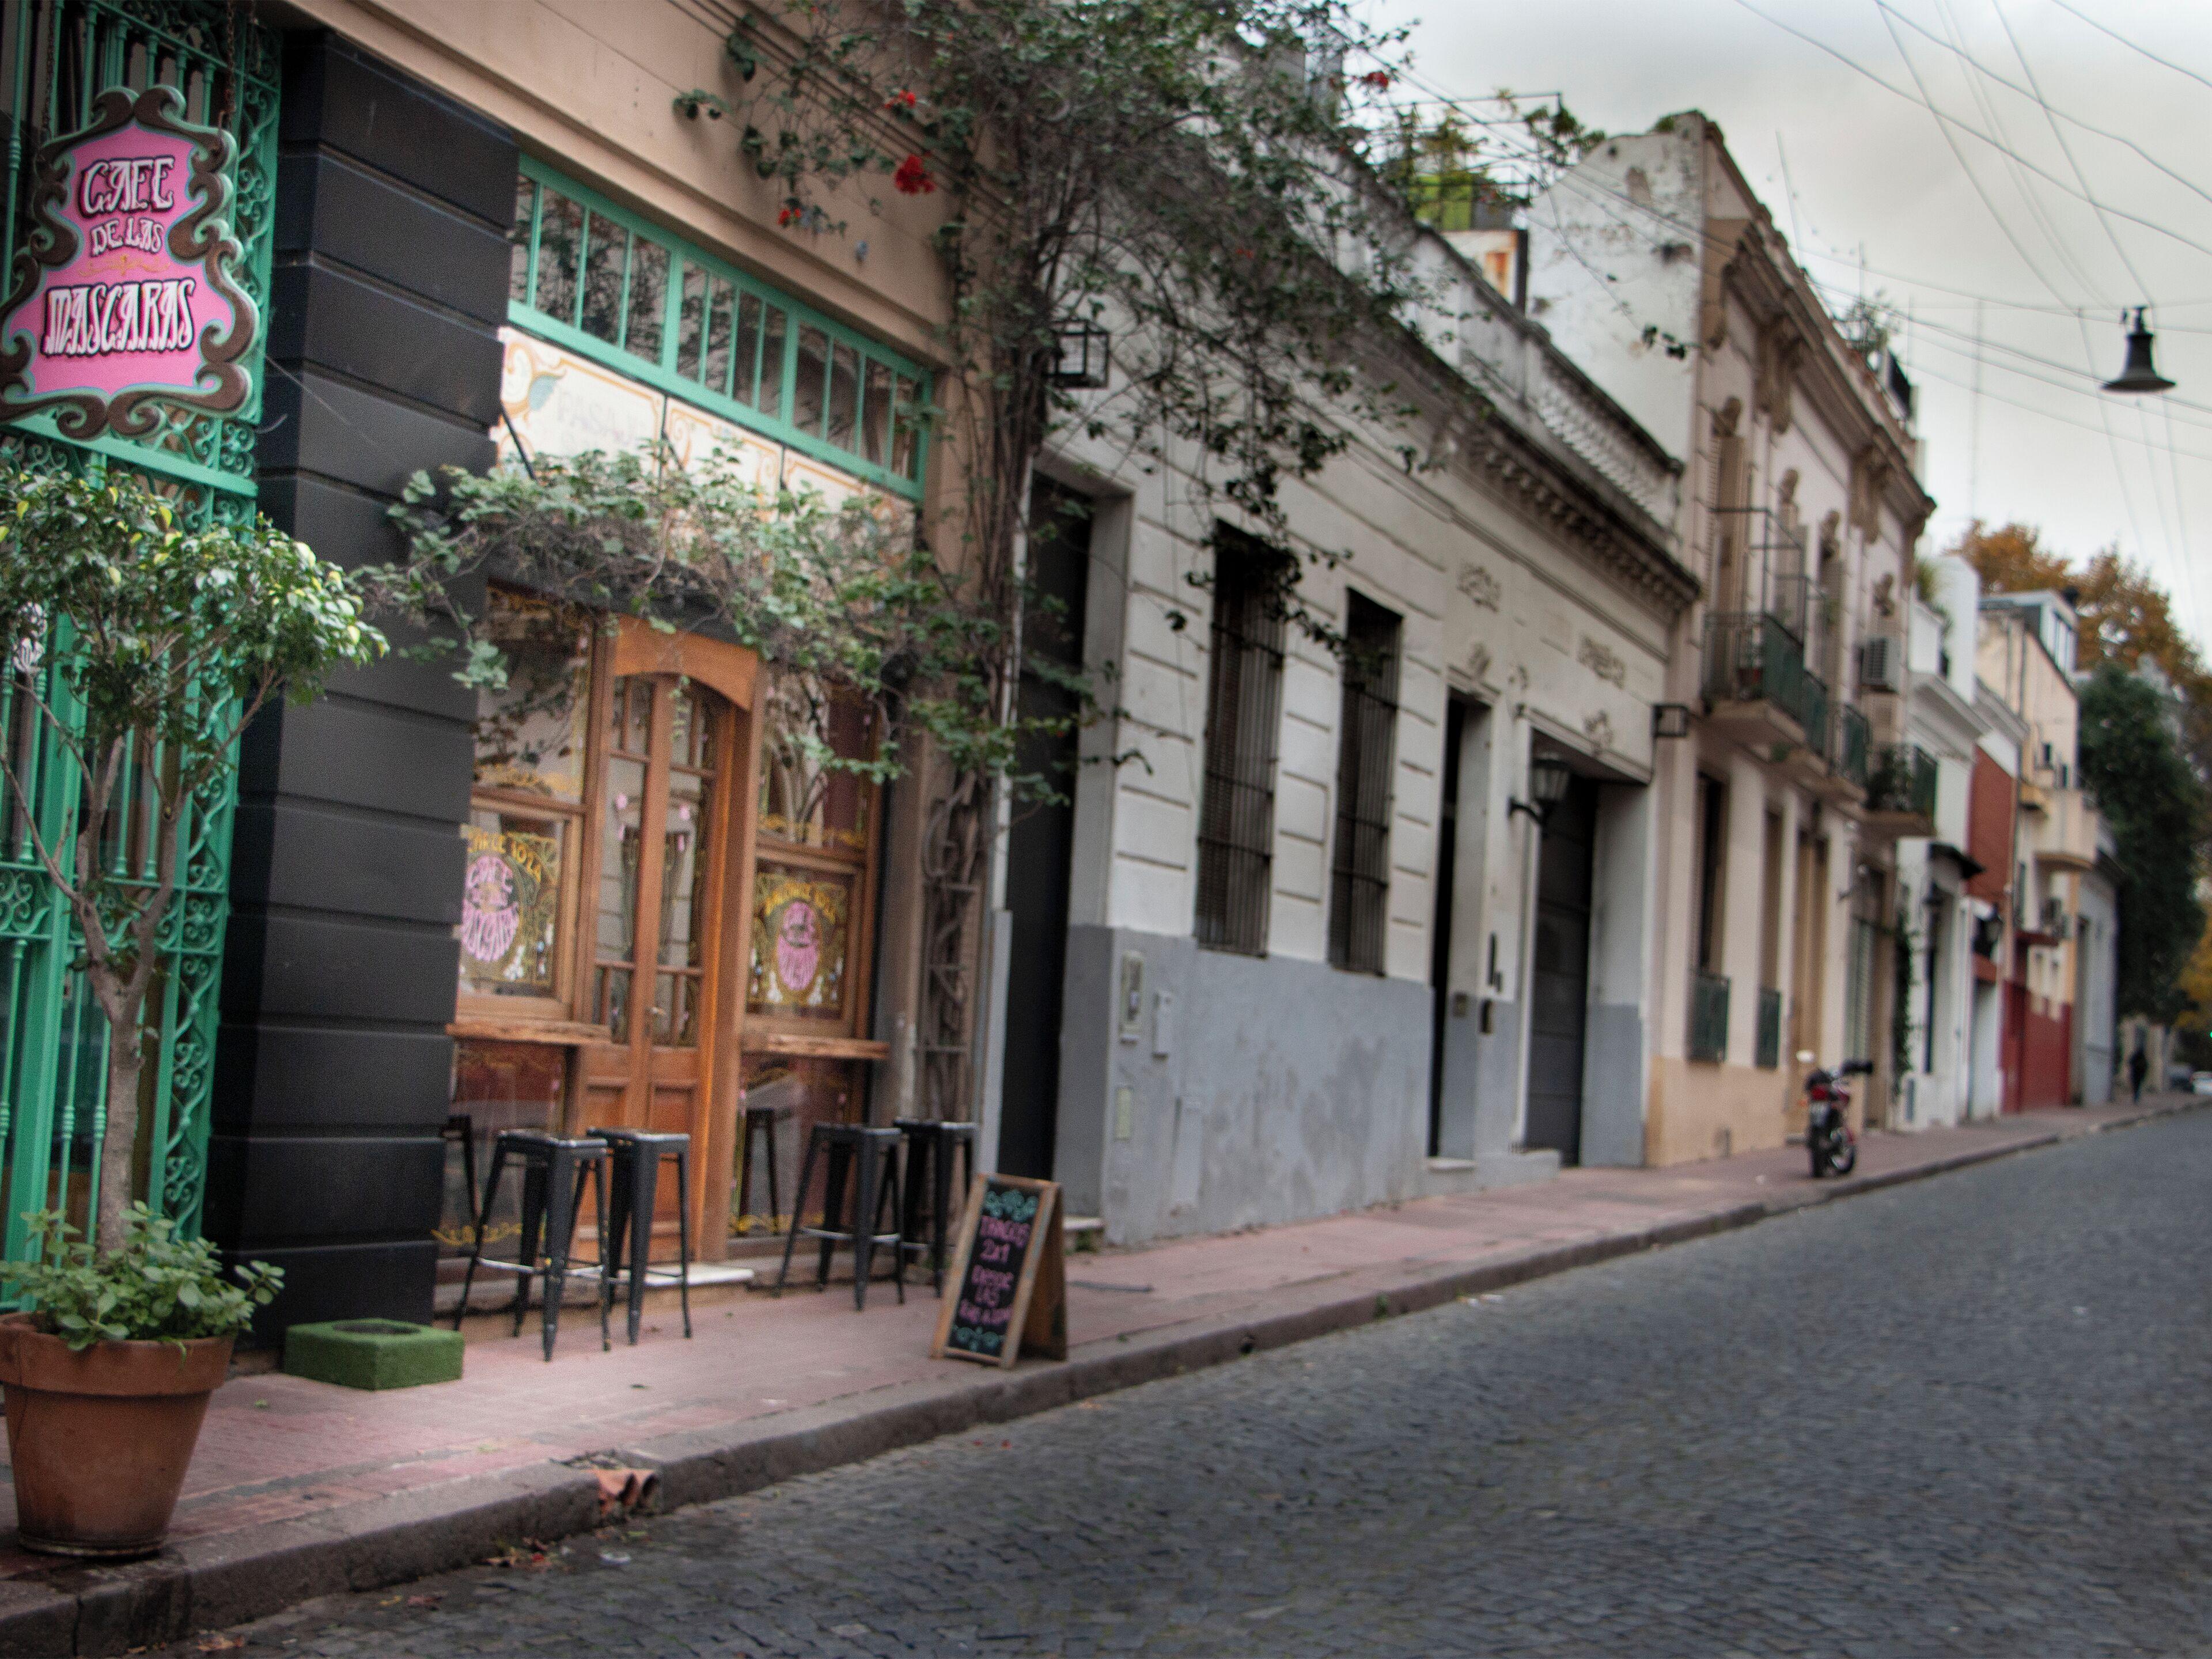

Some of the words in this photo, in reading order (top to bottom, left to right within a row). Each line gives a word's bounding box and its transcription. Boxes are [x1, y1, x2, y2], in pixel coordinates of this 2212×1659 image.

[78, 155, 175, 217] CAFE
[90, 219, 124, 257] DE
[124, 216, 165, 253] LAS
[43, 279, 196, 357] MASCARAS
